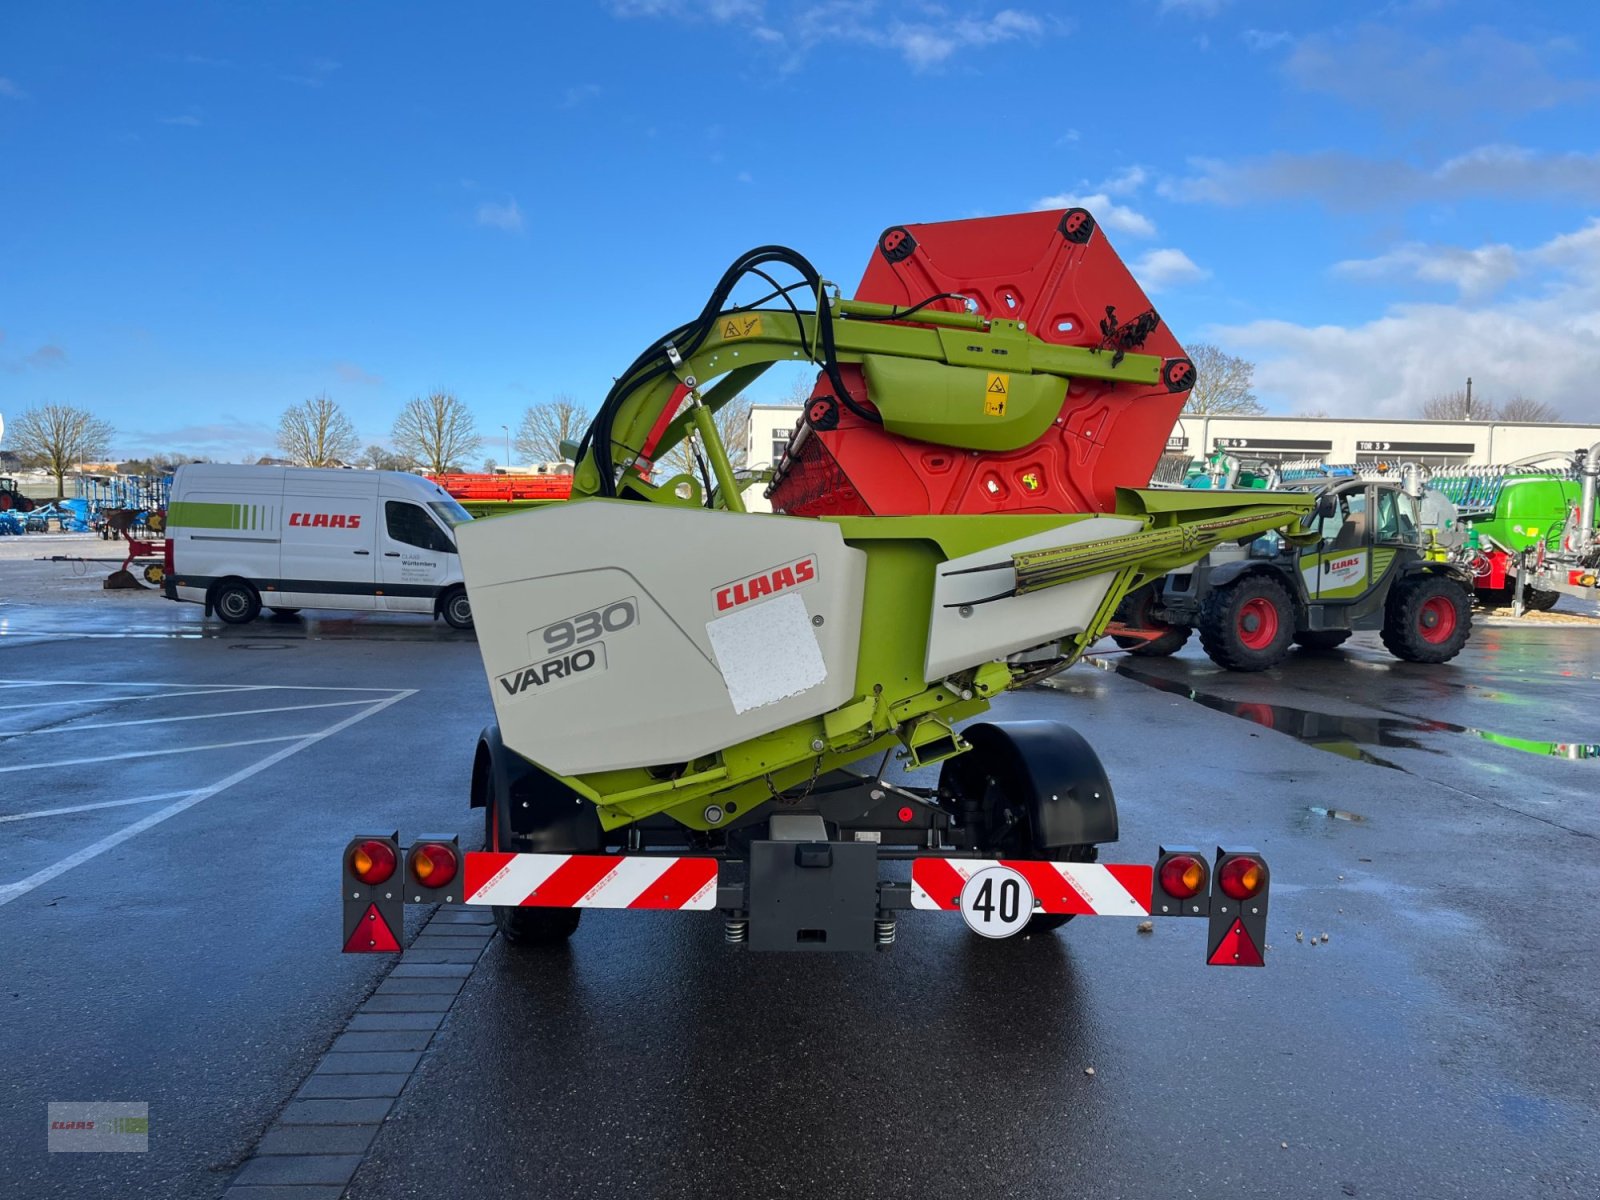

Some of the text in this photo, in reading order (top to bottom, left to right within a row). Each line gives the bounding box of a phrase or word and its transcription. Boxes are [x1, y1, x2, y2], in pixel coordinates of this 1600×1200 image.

[776, 429, 789, 437] TOR
[1217, 439, 1238, 447] TOR 4
[1360, 442, 1380, 450] TOR 3
[289, 512, 361, 528] CLAAS
[1332, 557, 1359, 570] CLAAS
[716, 558, 815, 612] CLAAS
[542, 601, 636, 655] 930
[500, 648, 595, 696] VARIO
[972, 877, 1020, 923] 40
